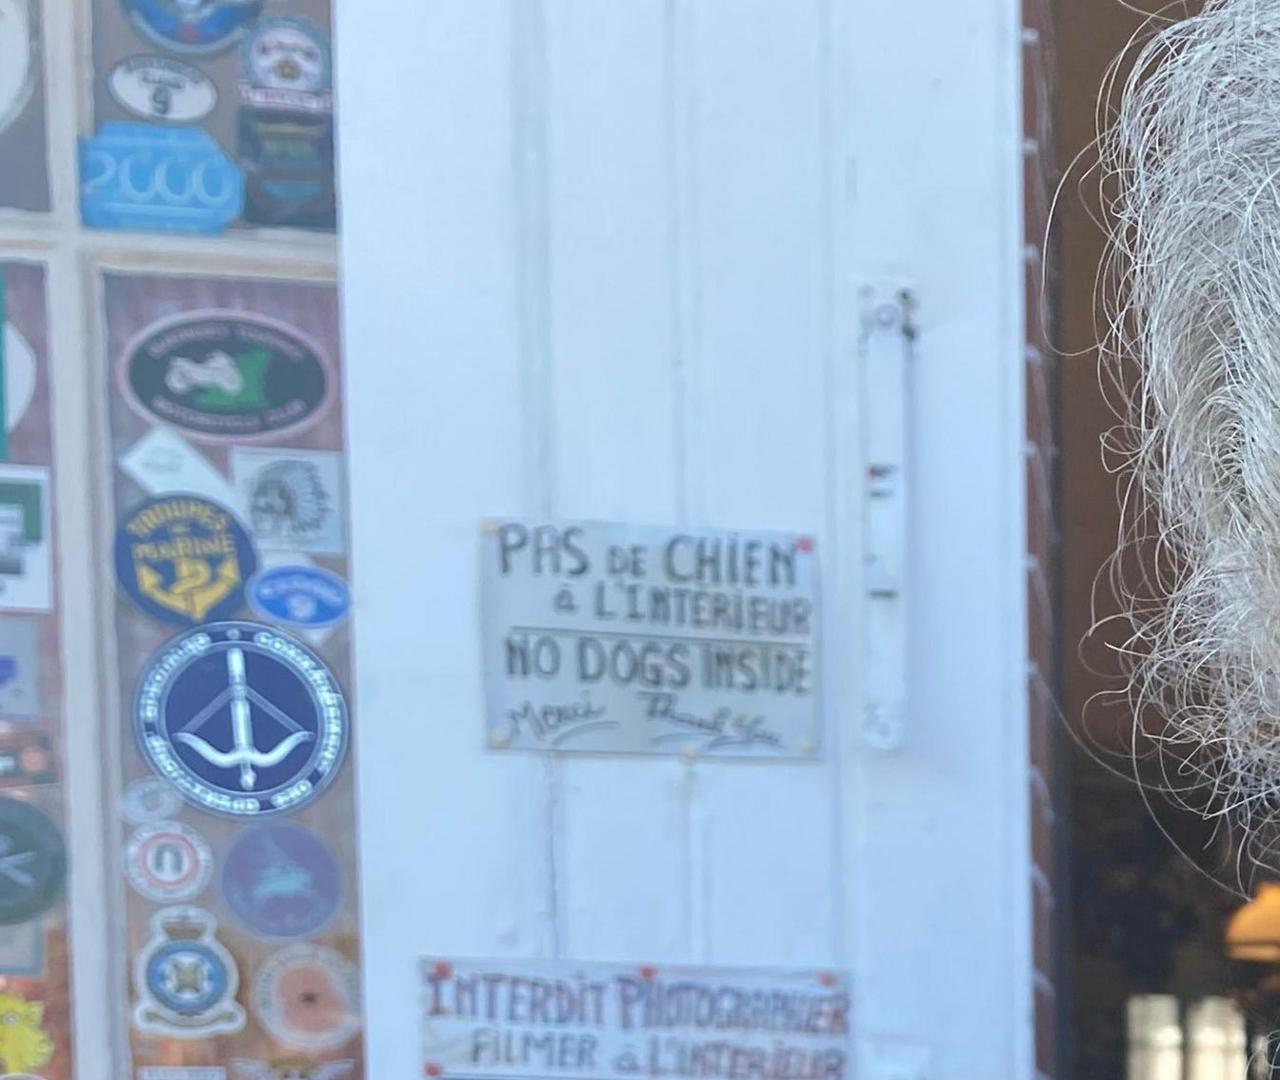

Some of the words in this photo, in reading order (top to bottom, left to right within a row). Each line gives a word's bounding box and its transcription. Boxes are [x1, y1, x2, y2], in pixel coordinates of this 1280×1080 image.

[84, 150, 233, 207] 2000
[132, 534, 237, 559] MARINE
[498, 523, 590, 576] PAS
[606, 543, 648, 576] DE
[664, 533, 798, 588] CHIEN
[505, 635, 562, 679] NO
[577, 637, 692, 690] DOGS
[702, 643, 811, 695] INSIDE
[426, 972, 605, 1026] INTERDIT
[471, 1029, 598, 1069] FILMER
